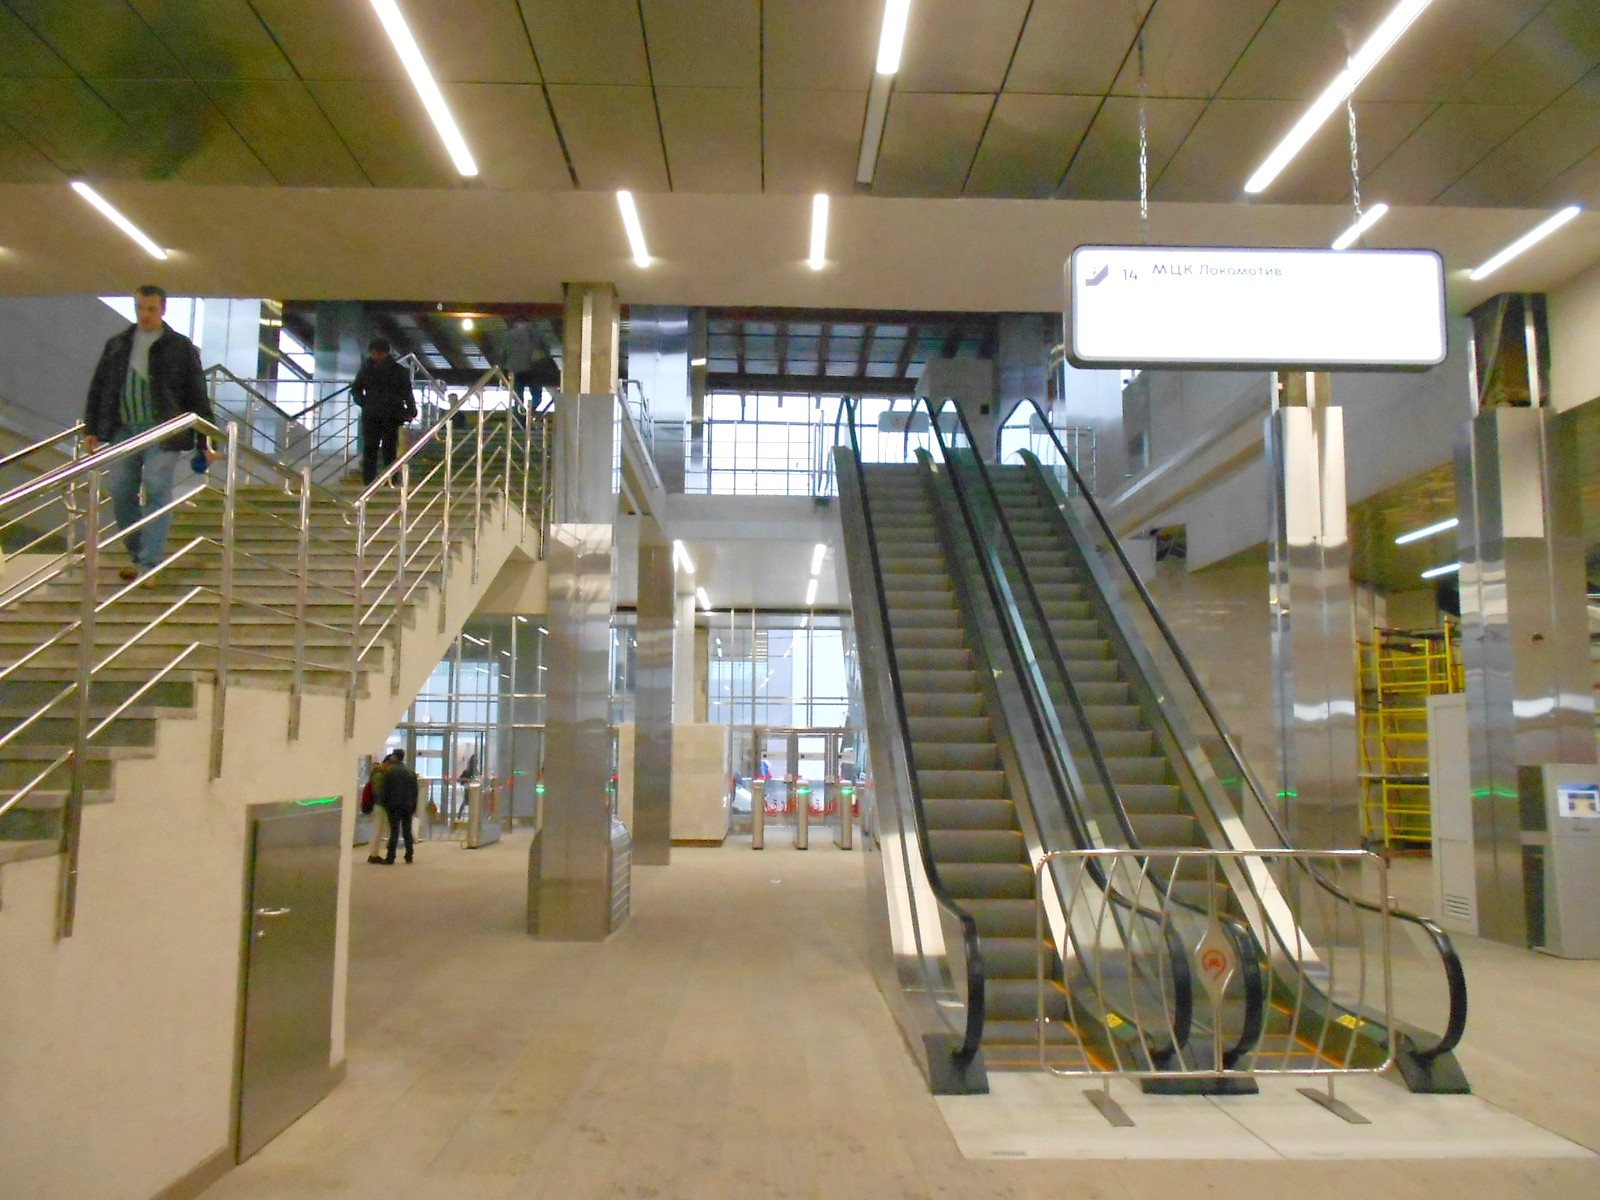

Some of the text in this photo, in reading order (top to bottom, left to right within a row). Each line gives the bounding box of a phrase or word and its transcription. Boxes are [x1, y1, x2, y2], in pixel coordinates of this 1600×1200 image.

[1122, 264, 1282, 281] 14 МЦК Локомотив
